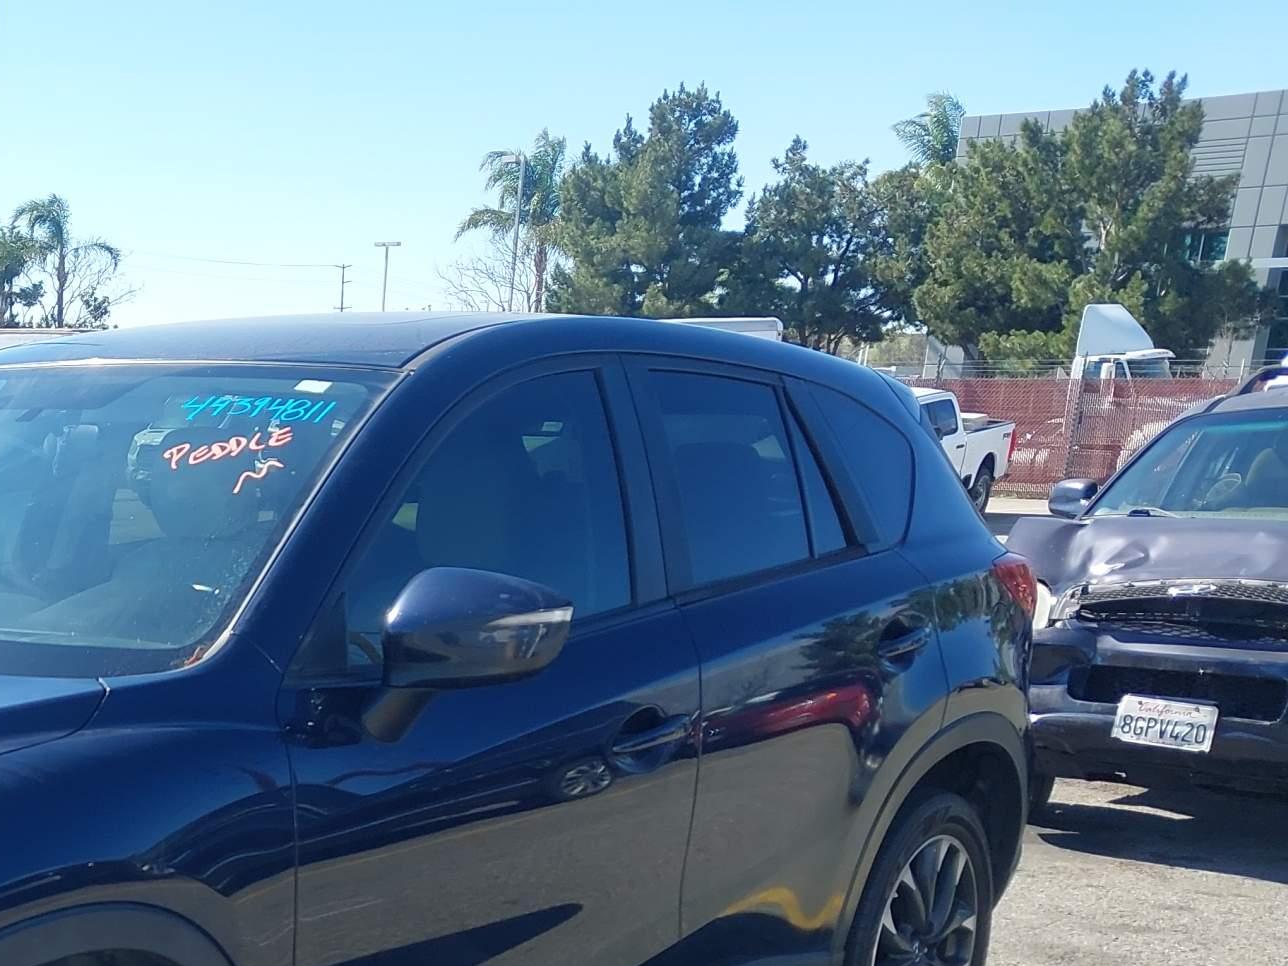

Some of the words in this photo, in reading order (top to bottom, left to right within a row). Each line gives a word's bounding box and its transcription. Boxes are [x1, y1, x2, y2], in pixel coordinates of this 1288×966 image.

[163, 426, 294, 470] PEDDLE
[1137, 701, 1193, 717] California
[1120, 714, 1207, 744] 8GPV420
